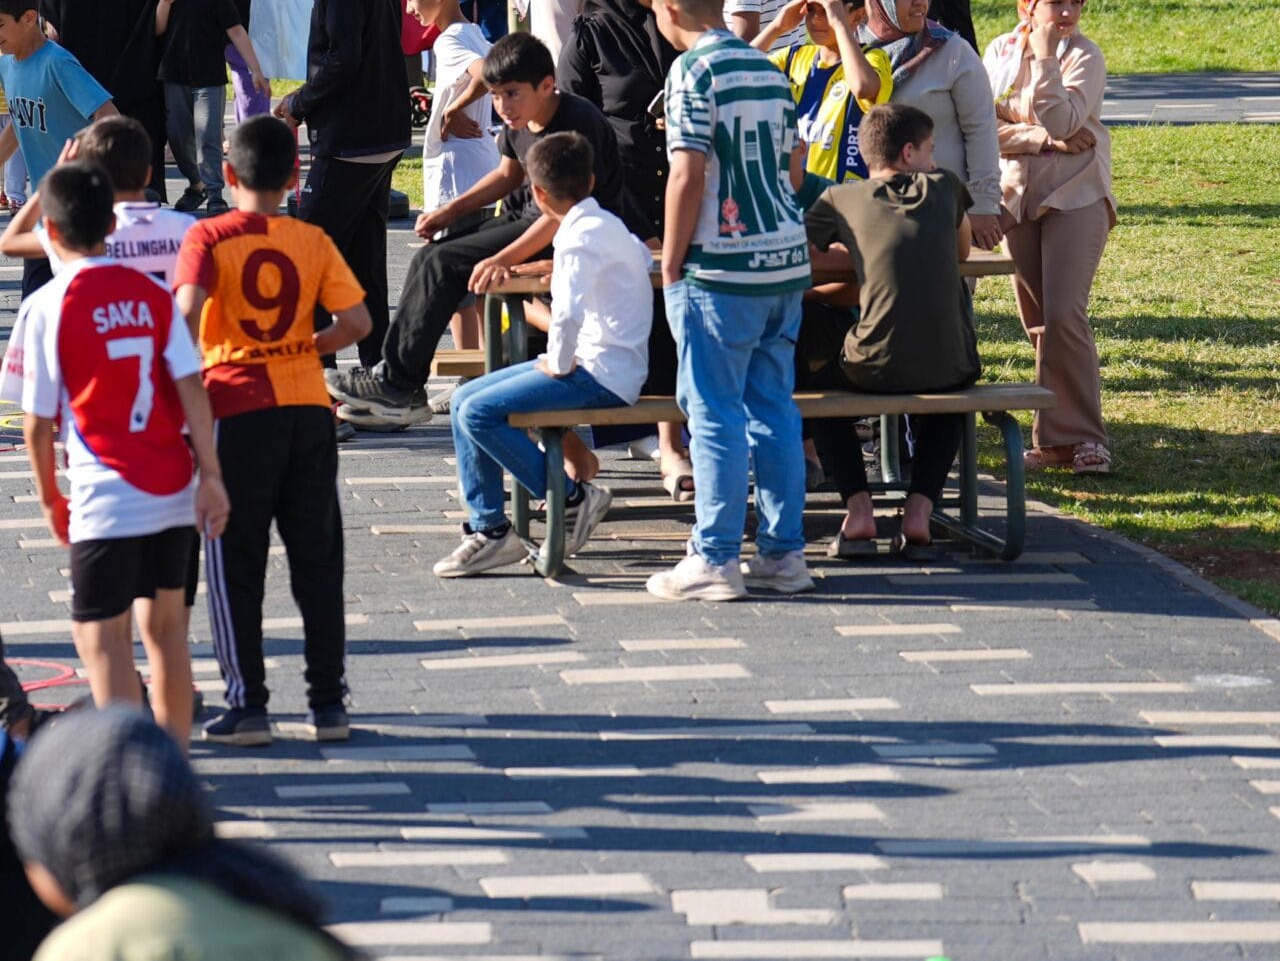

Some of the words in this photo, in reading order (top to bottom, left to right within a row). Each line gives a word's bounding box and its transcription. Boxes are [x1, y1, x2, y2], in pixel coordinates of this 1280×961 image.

[846, 124, 860, 167] PORT
[92, 300, 155, 334] SAKA
[239, 248, 300, 343] 9
[106, 336, 154, 432] 7
